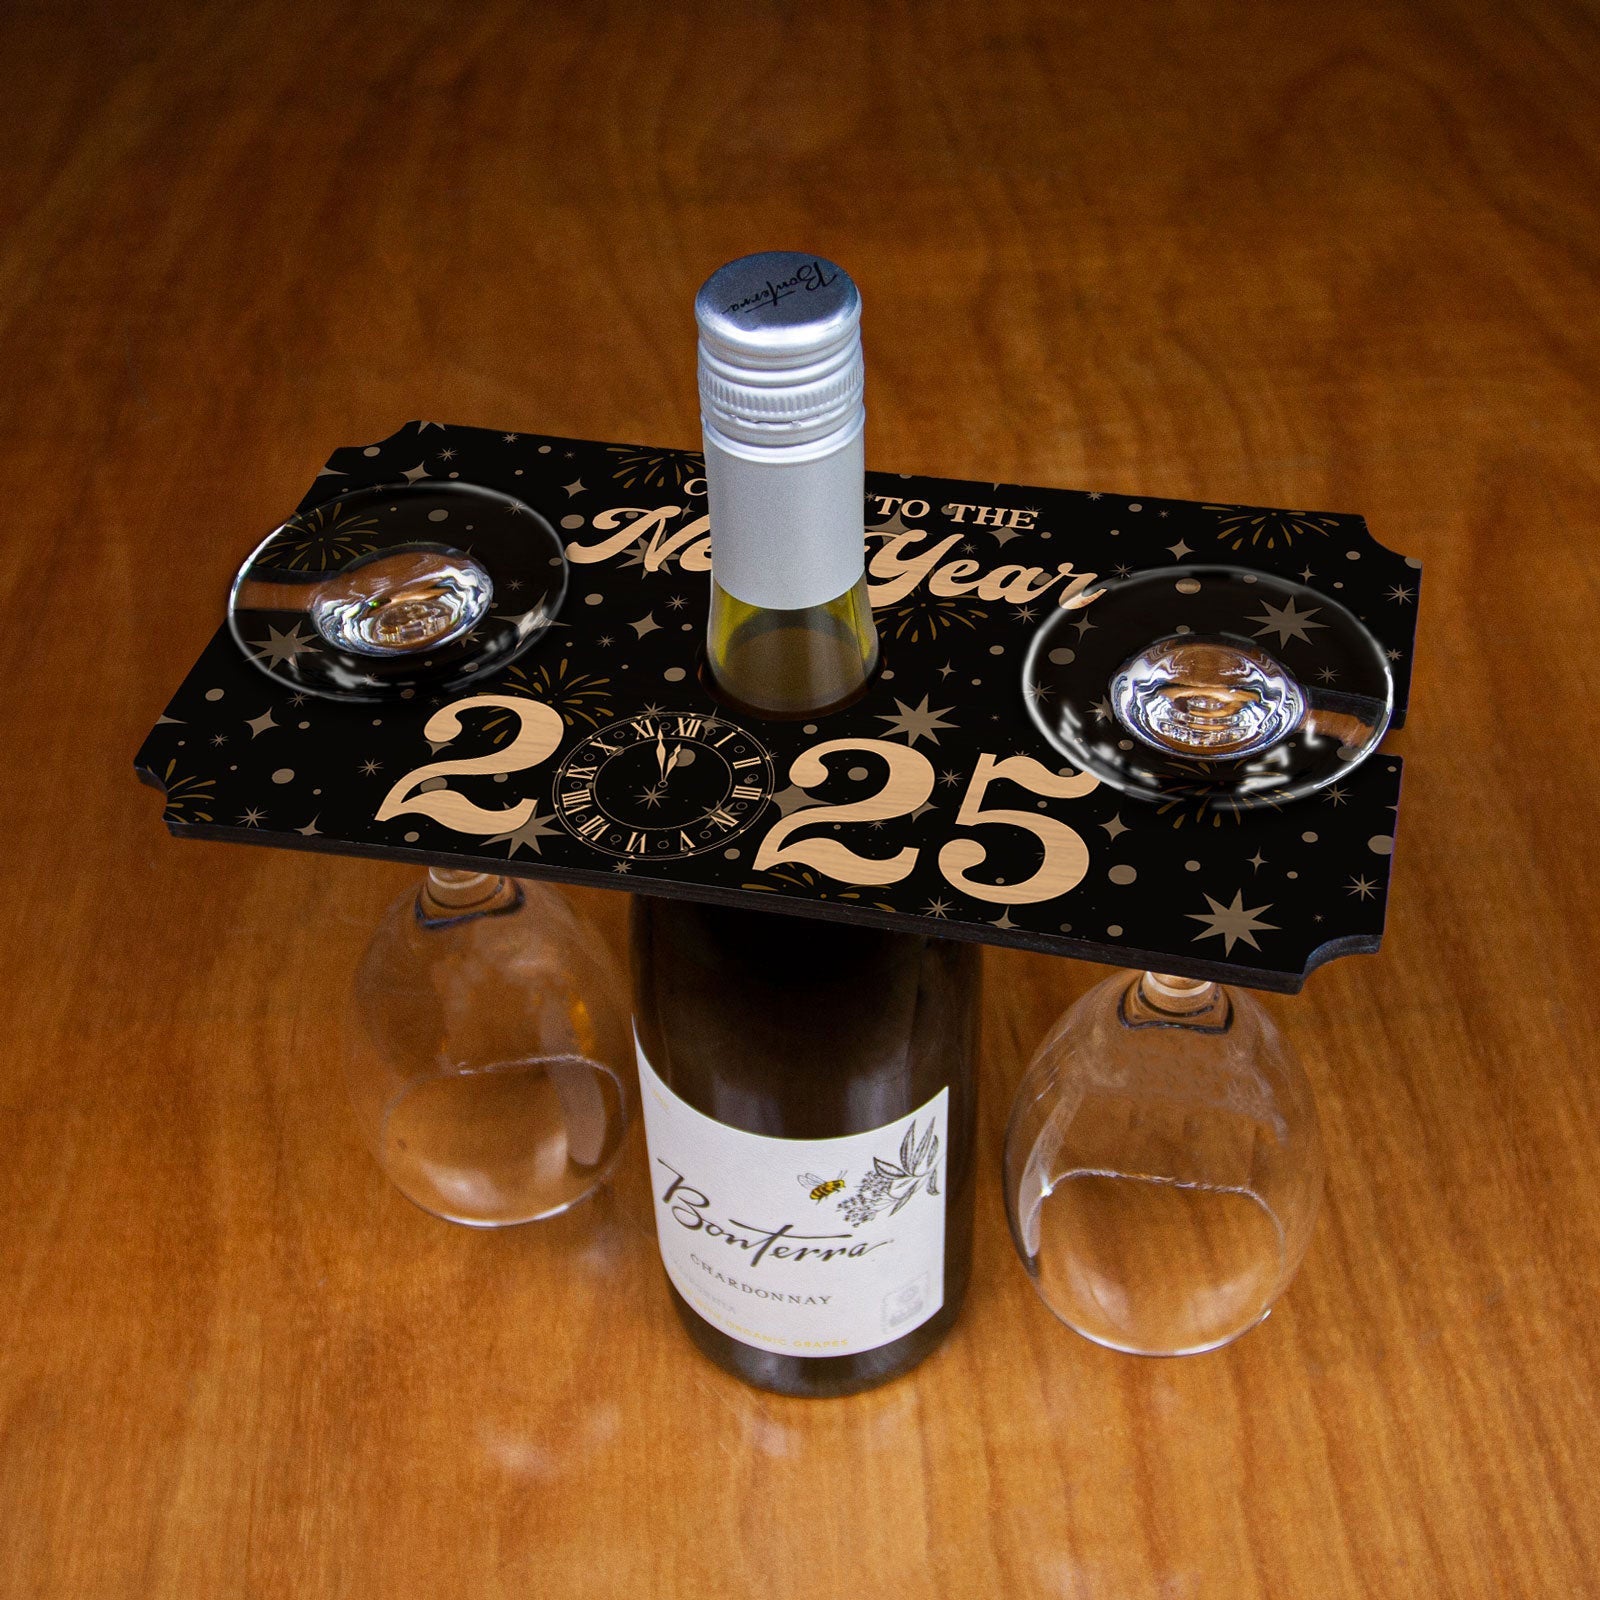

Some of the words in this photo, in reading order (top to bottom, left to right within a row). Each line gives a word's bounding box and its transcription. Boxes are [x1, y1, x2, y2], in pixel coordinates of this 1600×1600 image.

[722, 262, 837, 313] Bonterra
[874, 495, 931, 519] TO
[948, 503, 1039, 530] THE
[565, 505, 712, 572] Ne
[864, 529, 1108, 610] Year
[630, 719, 655, 740] XI
[671, 717, 702, 738] XII
[590, 737, 619, 756] X
[714, 731, 737, 748] I
[566, 763, 598, 780] IX
[732, 756, 762, 769] II
[731, 785, 763, 800] III
[625, 831, 647, 854] VI
[680, 830, 696, 851] V
[657, 1158, 894, 1267] Bonterra
[690, 1253, 832, 1305] CHARDONNAY
